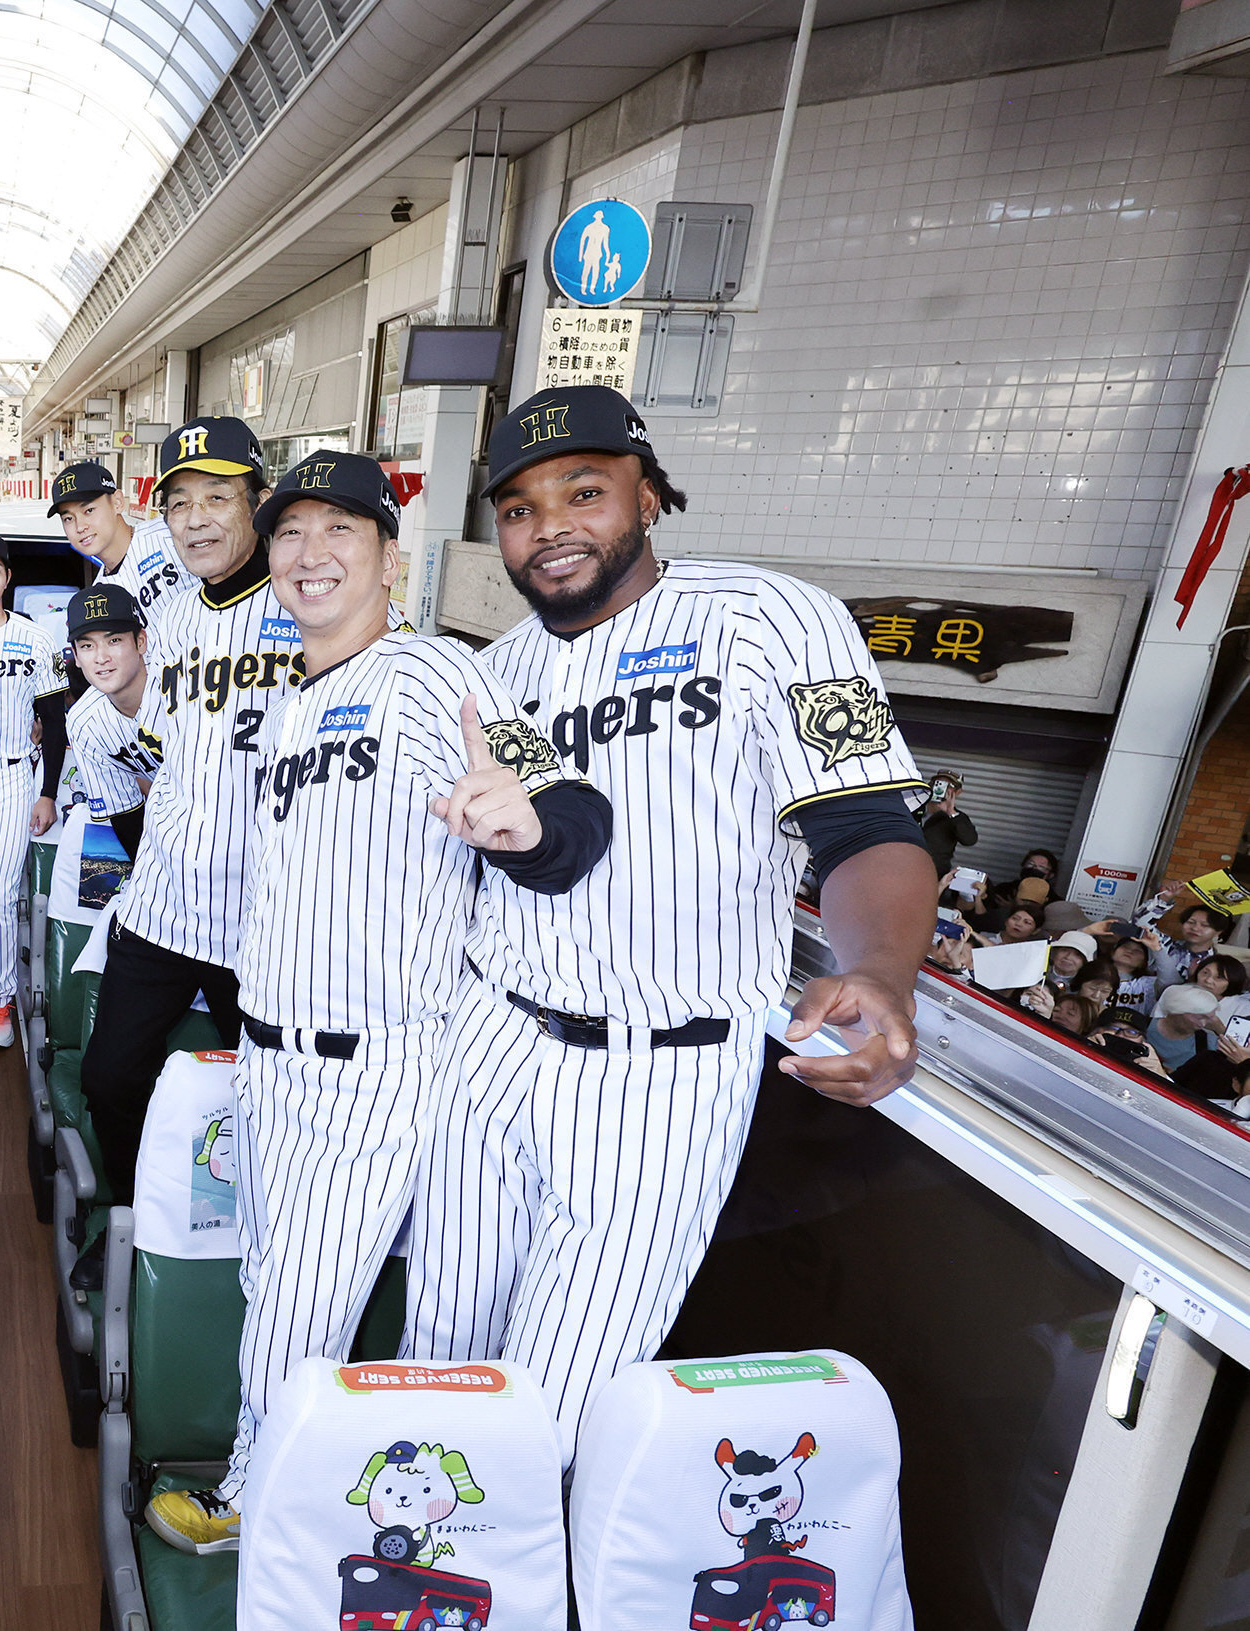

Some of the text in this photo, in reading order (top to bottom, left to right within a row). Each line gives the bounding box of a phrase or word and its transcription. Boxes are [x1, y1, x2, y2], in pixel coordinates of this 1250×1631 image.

[549, 336, 629, 353] の積降のための貨
[547, 355, 626, 372] 物自動車を除く
[139, 554, 163, 574] Joshin
[139, 563, 179, 608] ers
[4, 642, 32, 654] Joshin
[867, 615, 984, 664] 青果
[619, 650, 695, 675] Joshin
[162, 647, 306, 714] Tigers
[321, 710, 366, 728] Joshin
[525, 675, 722, 773] gers
[851, 742, 886, 752] Tigers
[191, 1219, 221, 1231] 美人の湯
[358, 1371, 400, 1385] SEAT
[695, 1370, 733, 1381] SEAT
